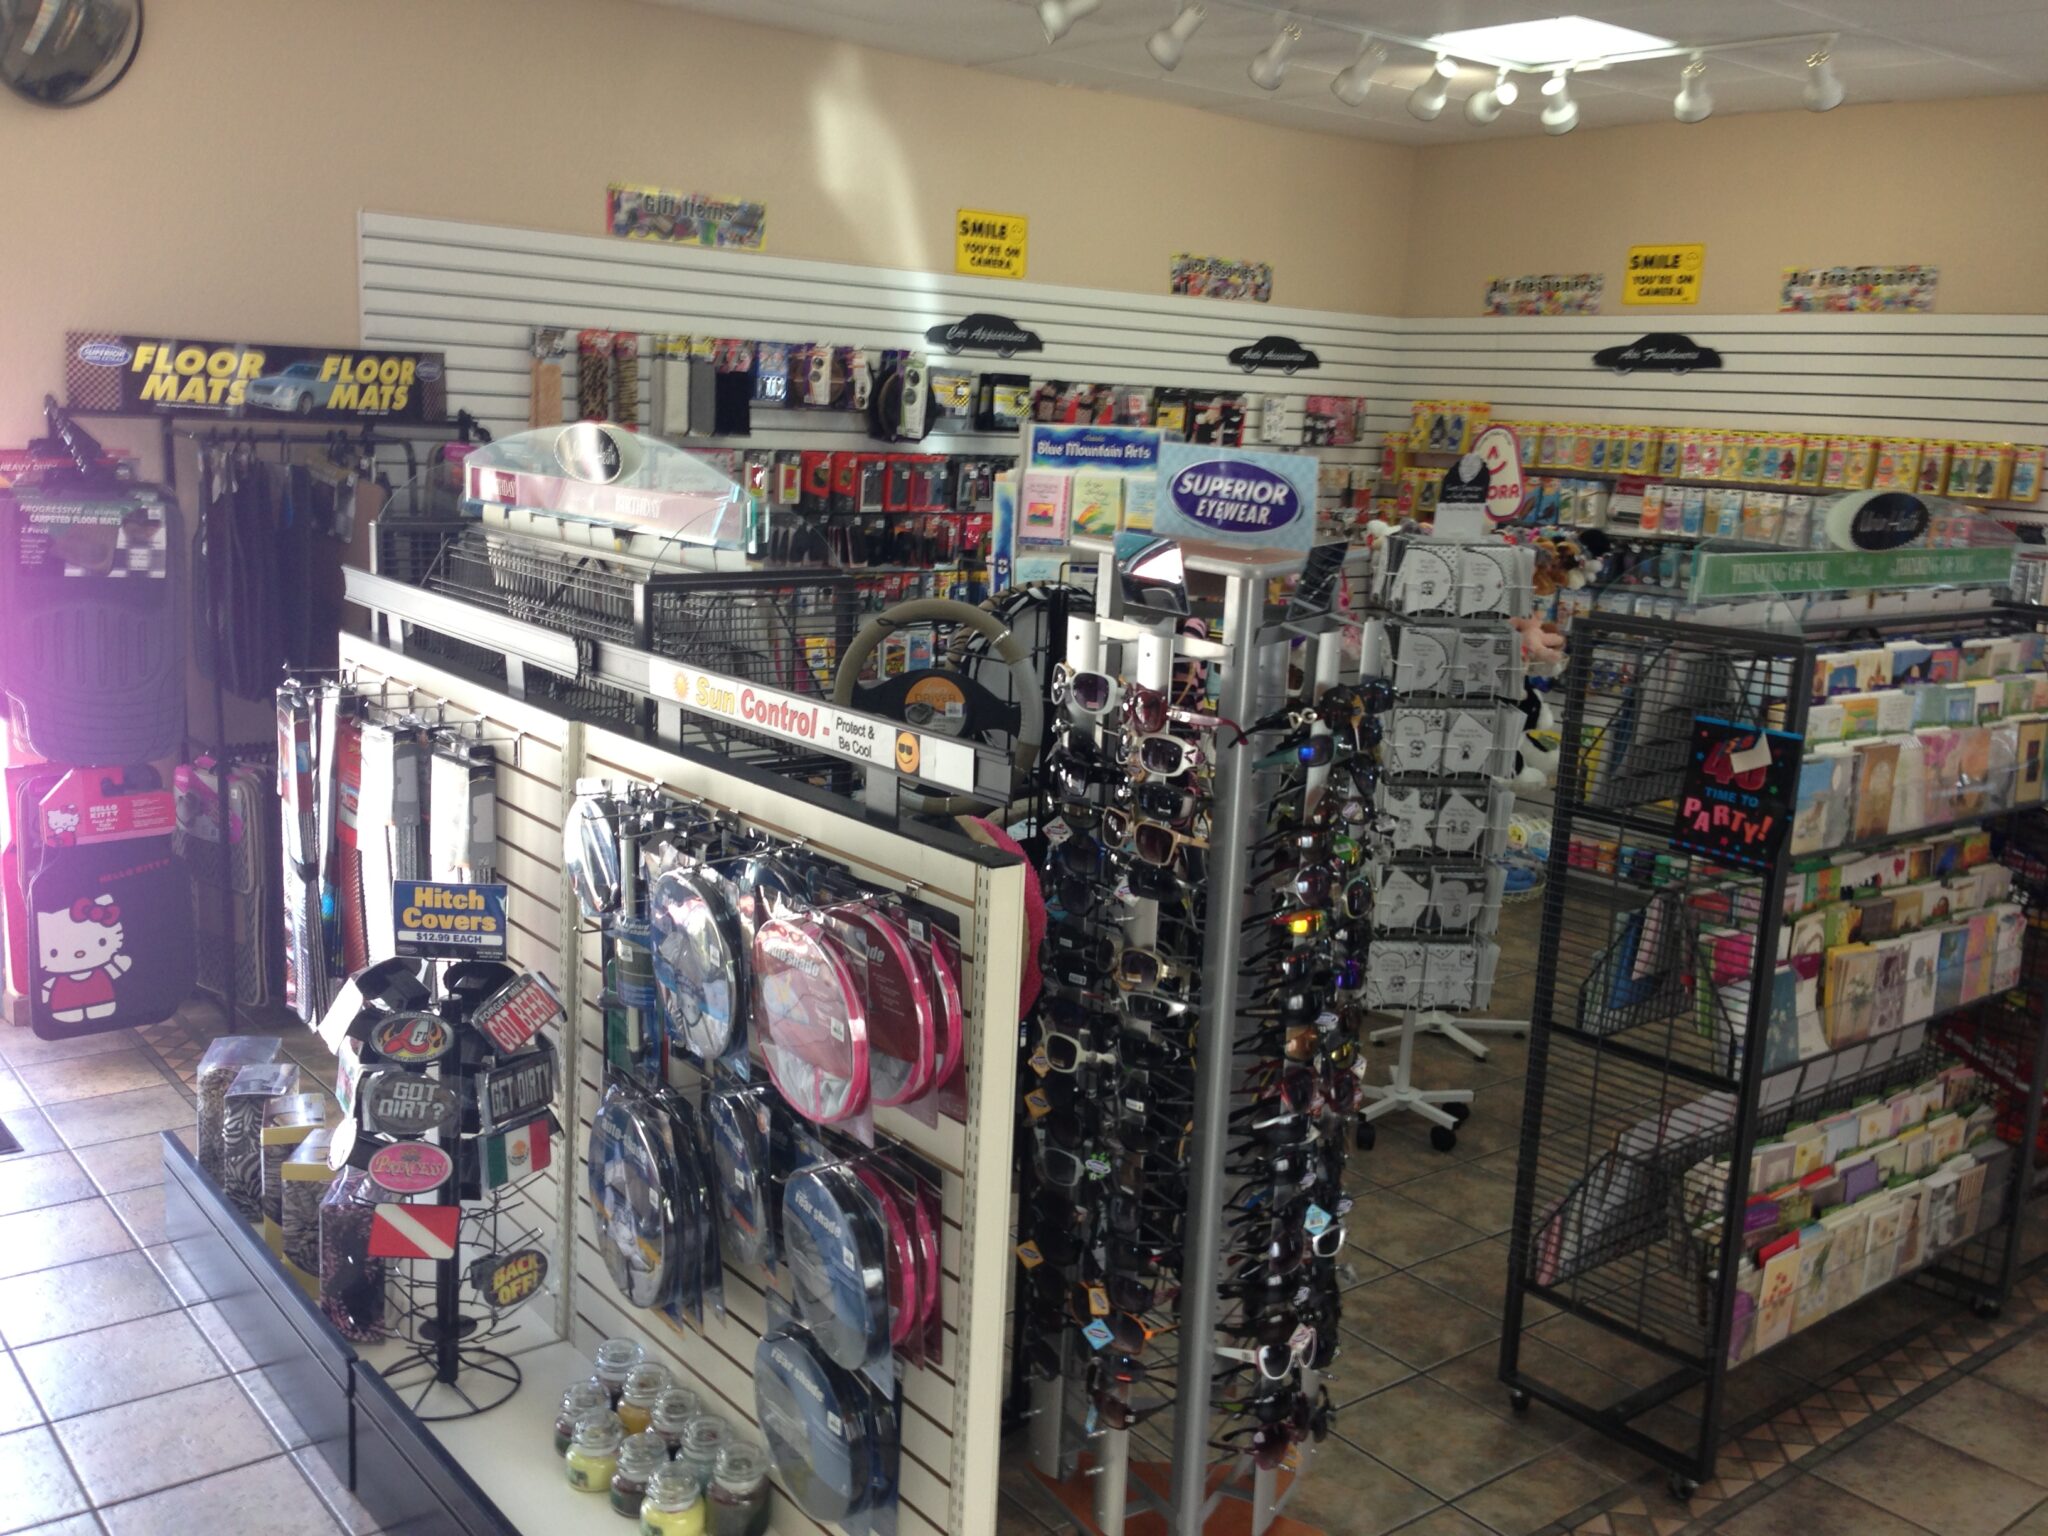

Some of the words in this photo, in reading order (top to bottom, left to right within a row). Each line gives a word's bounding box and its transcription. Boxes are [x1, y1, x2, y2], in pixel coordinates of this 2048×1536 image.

[960, 220, 1007, 240] SMILE
[964, 242, 1000, 256] YOU'RE
[1005, 247, 1020, 257] ON
[970, 256, 1011, 269] CAMERA
[1630, 255, 1680, 270] SMILE
[1632, 274, 1671, 285] YOU'RE
[1677, 275, 1694, 284] ON
[1638, 287, 1682, 297] CAMERA
[131, 343, 266, 379] FLOOR
[319, 355, 416, 385] FLOOR
[139, 375, 249, 406] MATS
[326, 383, 409, 410] MATS
[1037, 441, 1063, 455] Blue
[1065, 442, 1122, 458] Mountain
[1123, 445, 1151, 459] Arts
[1178, 472, 1289, 507] SUPERIOR
[19, 504, 83, 515] PROGRESSIVE
[29, 514, 70, 524] CARPETED
[72, 515, 98, 525] FLOOR
[100, 515, 122, 525] MATS
[1195, 498, 1271, 525] EYEWEAR
[695, 676, 735, 713] Sun
[740, 687, 818, 740] Control
[836, 716, 866, 738] Protect
[867, 725, 875, 738] &
[838, 736, 851, 751] Be
[852, 740, 872, 758] Cool
[1706, 787, 1736, 802] TIME
[1742, 793, 1759, 807] TO
[90, 811, 119, 819] KITTY
[1683, 797, 1773, 843] PARTY!
[99, 868, 132, 883] HELLO
[135, 858, 170, 873] KITTY
[414, 887, 485, 910] Hitch
[403, 907, 497, 931] Covers
[416, 933, 450, 942] $12.99
[453, 934, 482, 943] EACH
[767, 945, 820, 977] uto-shade
[479, 995, 508, 1022] FORGET
[507, 980, 527, 998] MILK
[488, 1009, 526, 1050] GOT
[393, 1082, 440, 1101] GOT
[490, 1080, 514, 1118] GET
[517, 1063, 549, 1108] DIRTY
[377, 1099, 445, 1121] DIRT?
[795, 1190, 813, 1214] rear
[813, 1208, 842, 1238] shade
[493, 1253, 537, 1289] BACK
[499, 1270, 538, 1304] OFF!
[771, 1347, 794, 1372] rear
[794, 1368, 825, 1402] shade
